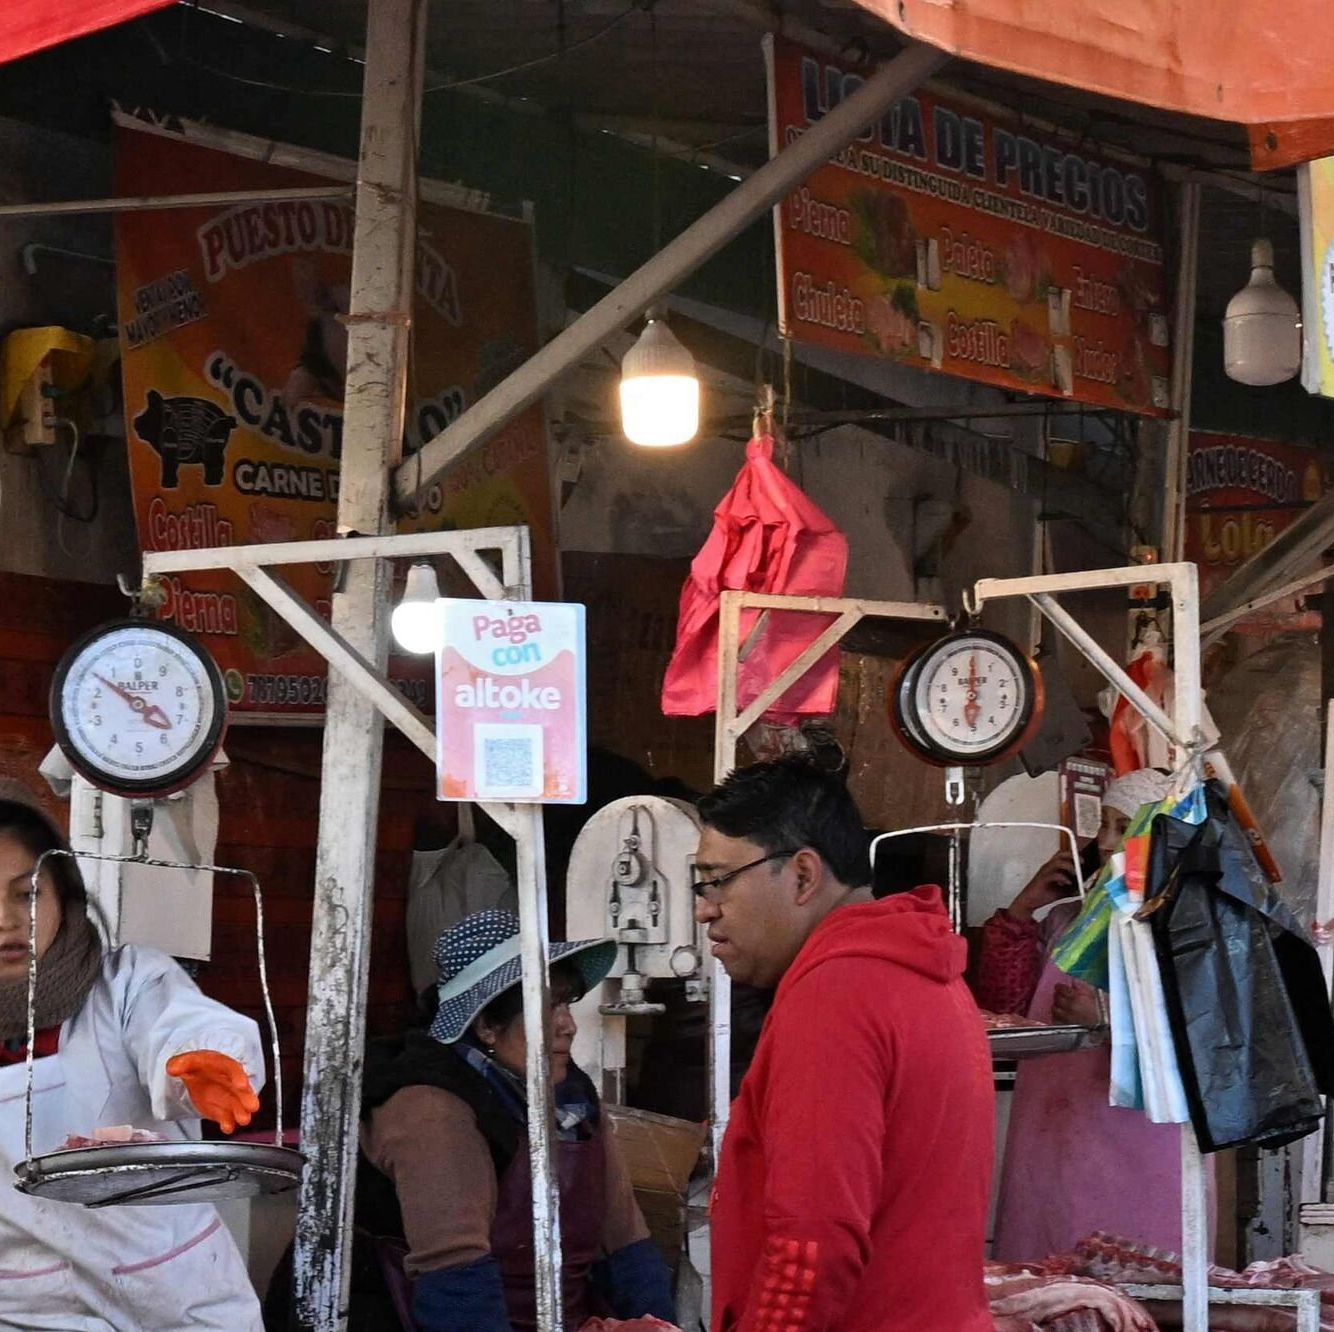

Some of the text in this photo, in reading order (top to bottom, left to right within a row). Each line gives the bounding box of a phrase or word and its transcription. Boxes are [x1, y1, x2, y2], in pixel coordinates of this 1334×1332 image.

[881, 156, 970, 208] DISTINGUIDA
[934, 104, 986, 181] DE
[993, 127, 1149, 232] PRECIOS
[201, 201, 355, 277] PUESTO D
[947, 310, 1011, 369] Costilla
[234, 463, 324, 499] CARNE
[472, 613, 542, 645] Paga
[492, 641, 541, 667] con
[246, 674, 328, 705] 7879502
[454, 678, 562, 710] altoke
